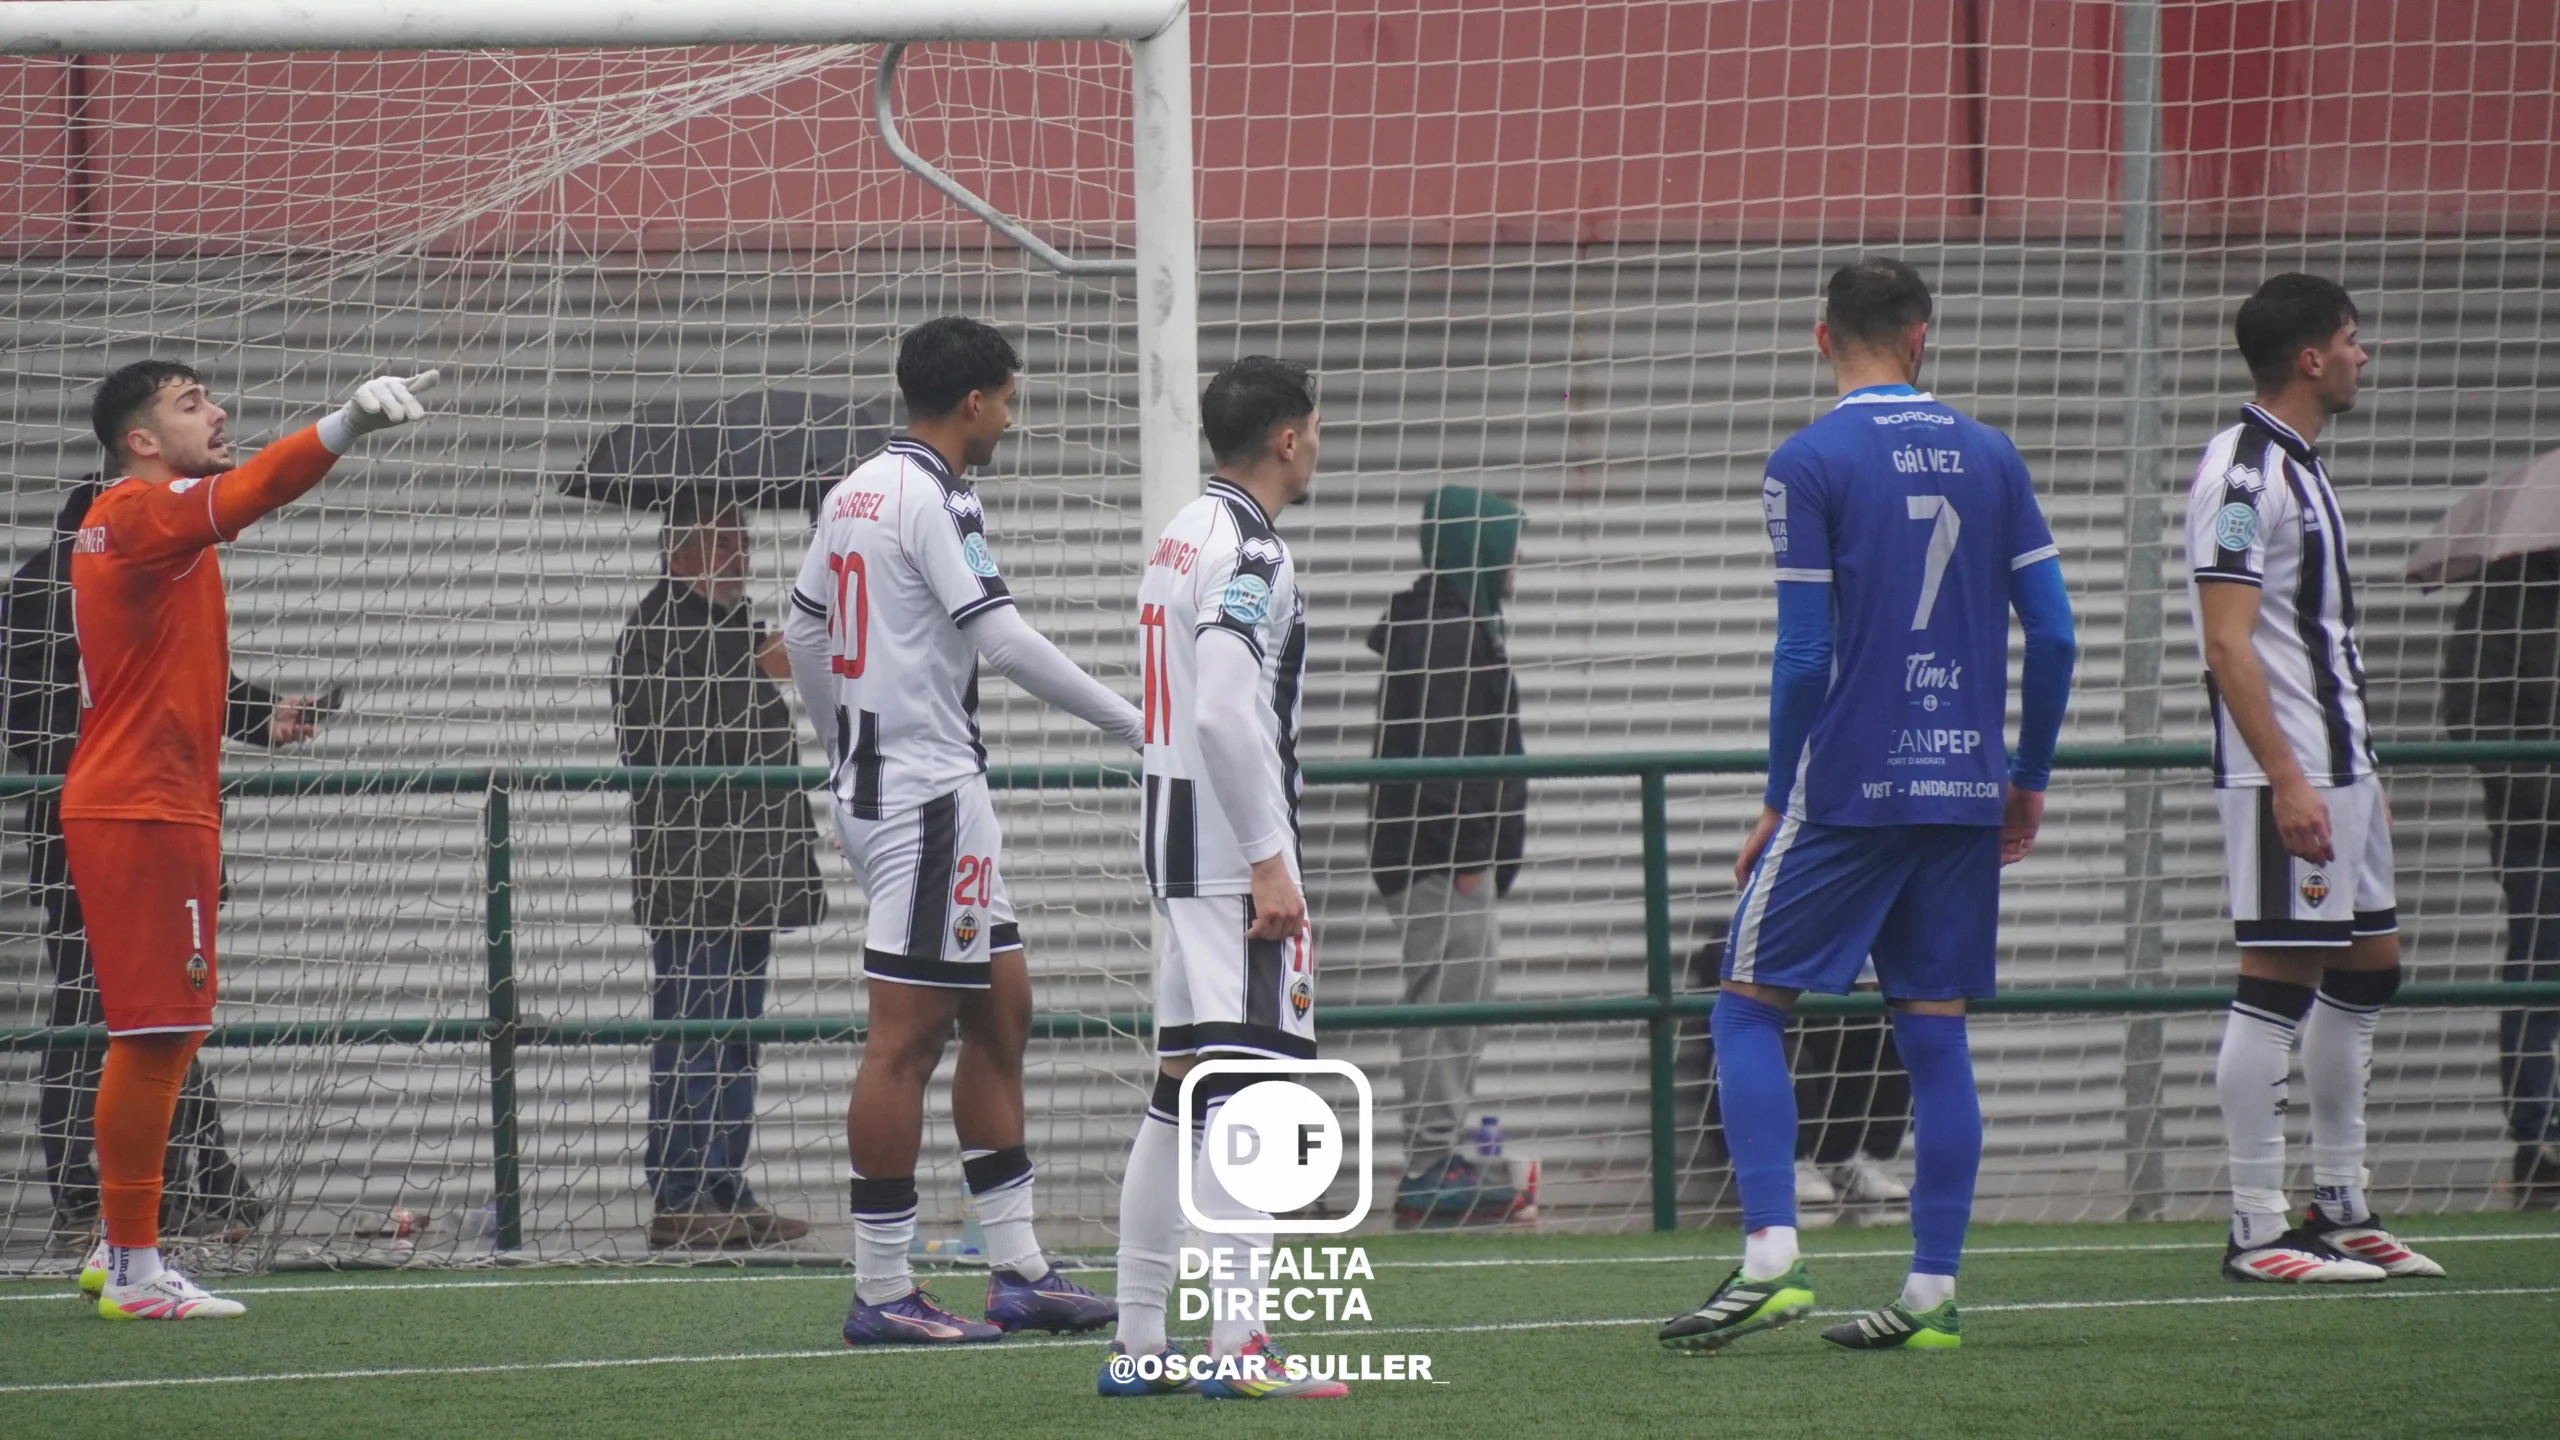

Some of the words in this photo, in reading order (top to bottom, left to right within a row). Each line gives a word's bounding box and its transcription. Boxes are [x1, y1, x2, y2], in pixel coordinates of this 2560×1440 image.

[1873, 411, 1955, 425] BORDOY
[1892, 443, 1965, 474] GÁLVEZ
[1906, 495, 1962, 632] 7
[1140, 603, 1171, 746] 11
[1905, 651, 1963, 692] Tim's
[953, 855, 992, 908] 20
[185, 899, 201, 950] 1
